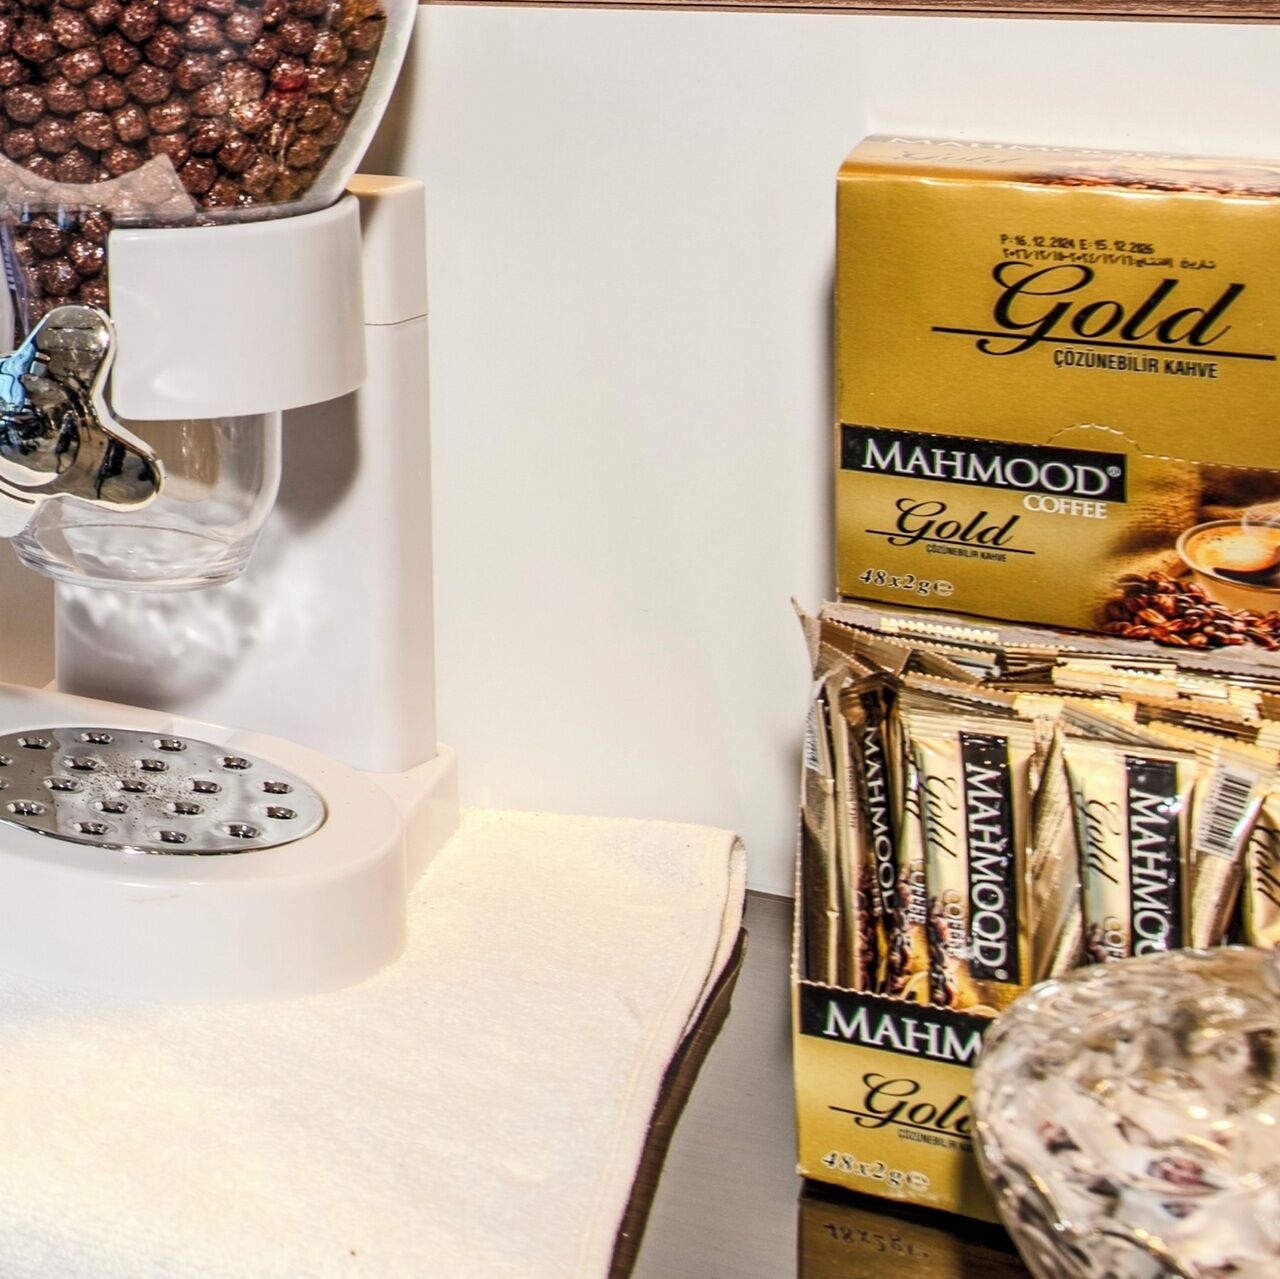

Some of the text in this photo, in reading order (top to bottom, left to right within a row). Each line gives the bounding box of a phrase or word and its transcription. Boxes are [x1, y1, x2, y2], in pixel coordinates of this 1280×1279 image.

[976, 261, 1246, 356] Gold
[1053, 347, 1218, 378] ÇÖZÜNEBİLİR KAHVE
[887, 497, 1021, 547] Gold
[1022, 493, 1108, 520] COFFEE
[822, 1000, 982, 1062] MAHM
